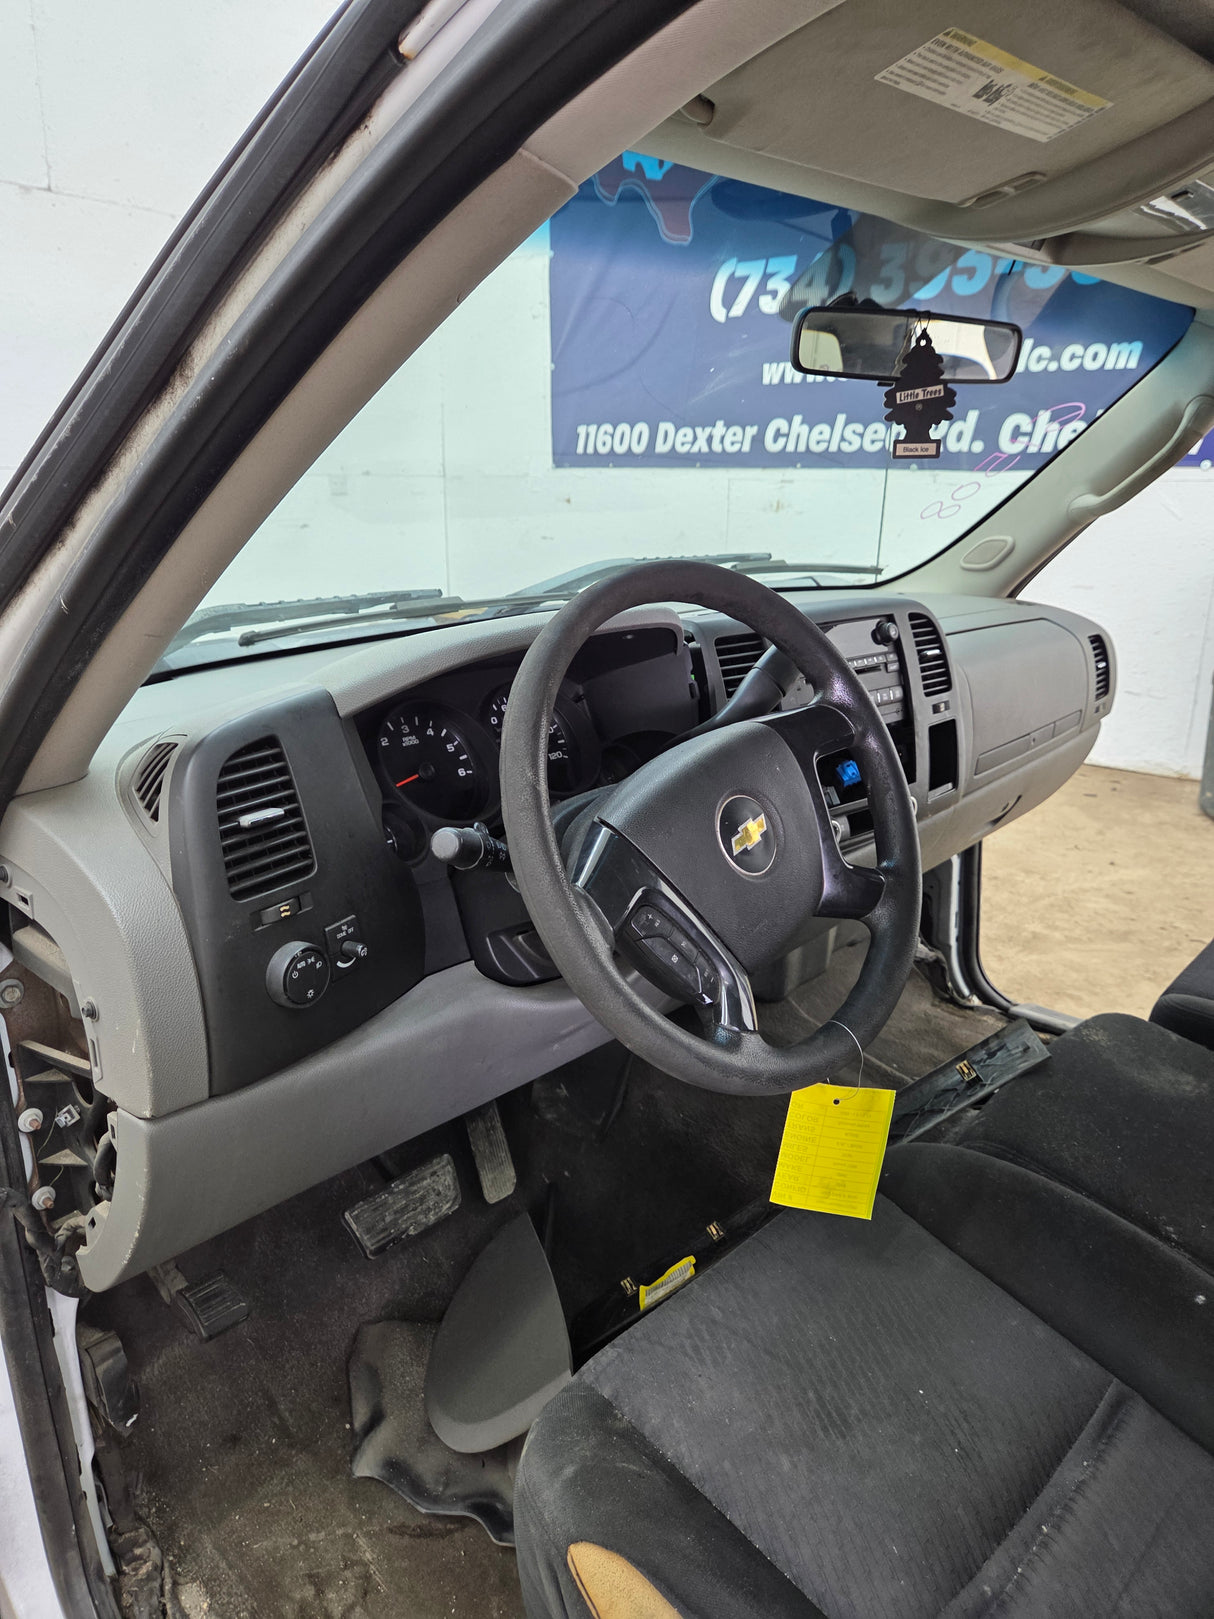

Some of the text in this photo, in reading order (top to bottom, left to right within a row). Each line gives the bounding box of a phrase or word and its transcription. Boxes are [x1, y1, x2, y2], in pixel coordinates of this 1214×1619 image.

[899, 387, 942, 402] Little Trees
[576, 422, 650, 455] 11600
[655, 420, 758, 454] Dexter
[903, 444, 919, 453] Black
[401, 724, 410, 734] 3
[426, 728, 435, 736] 4
[380, 737, 390, 747] 2
[446, 743, 455, 753] 5
[457, 768, 466, 777] 6
